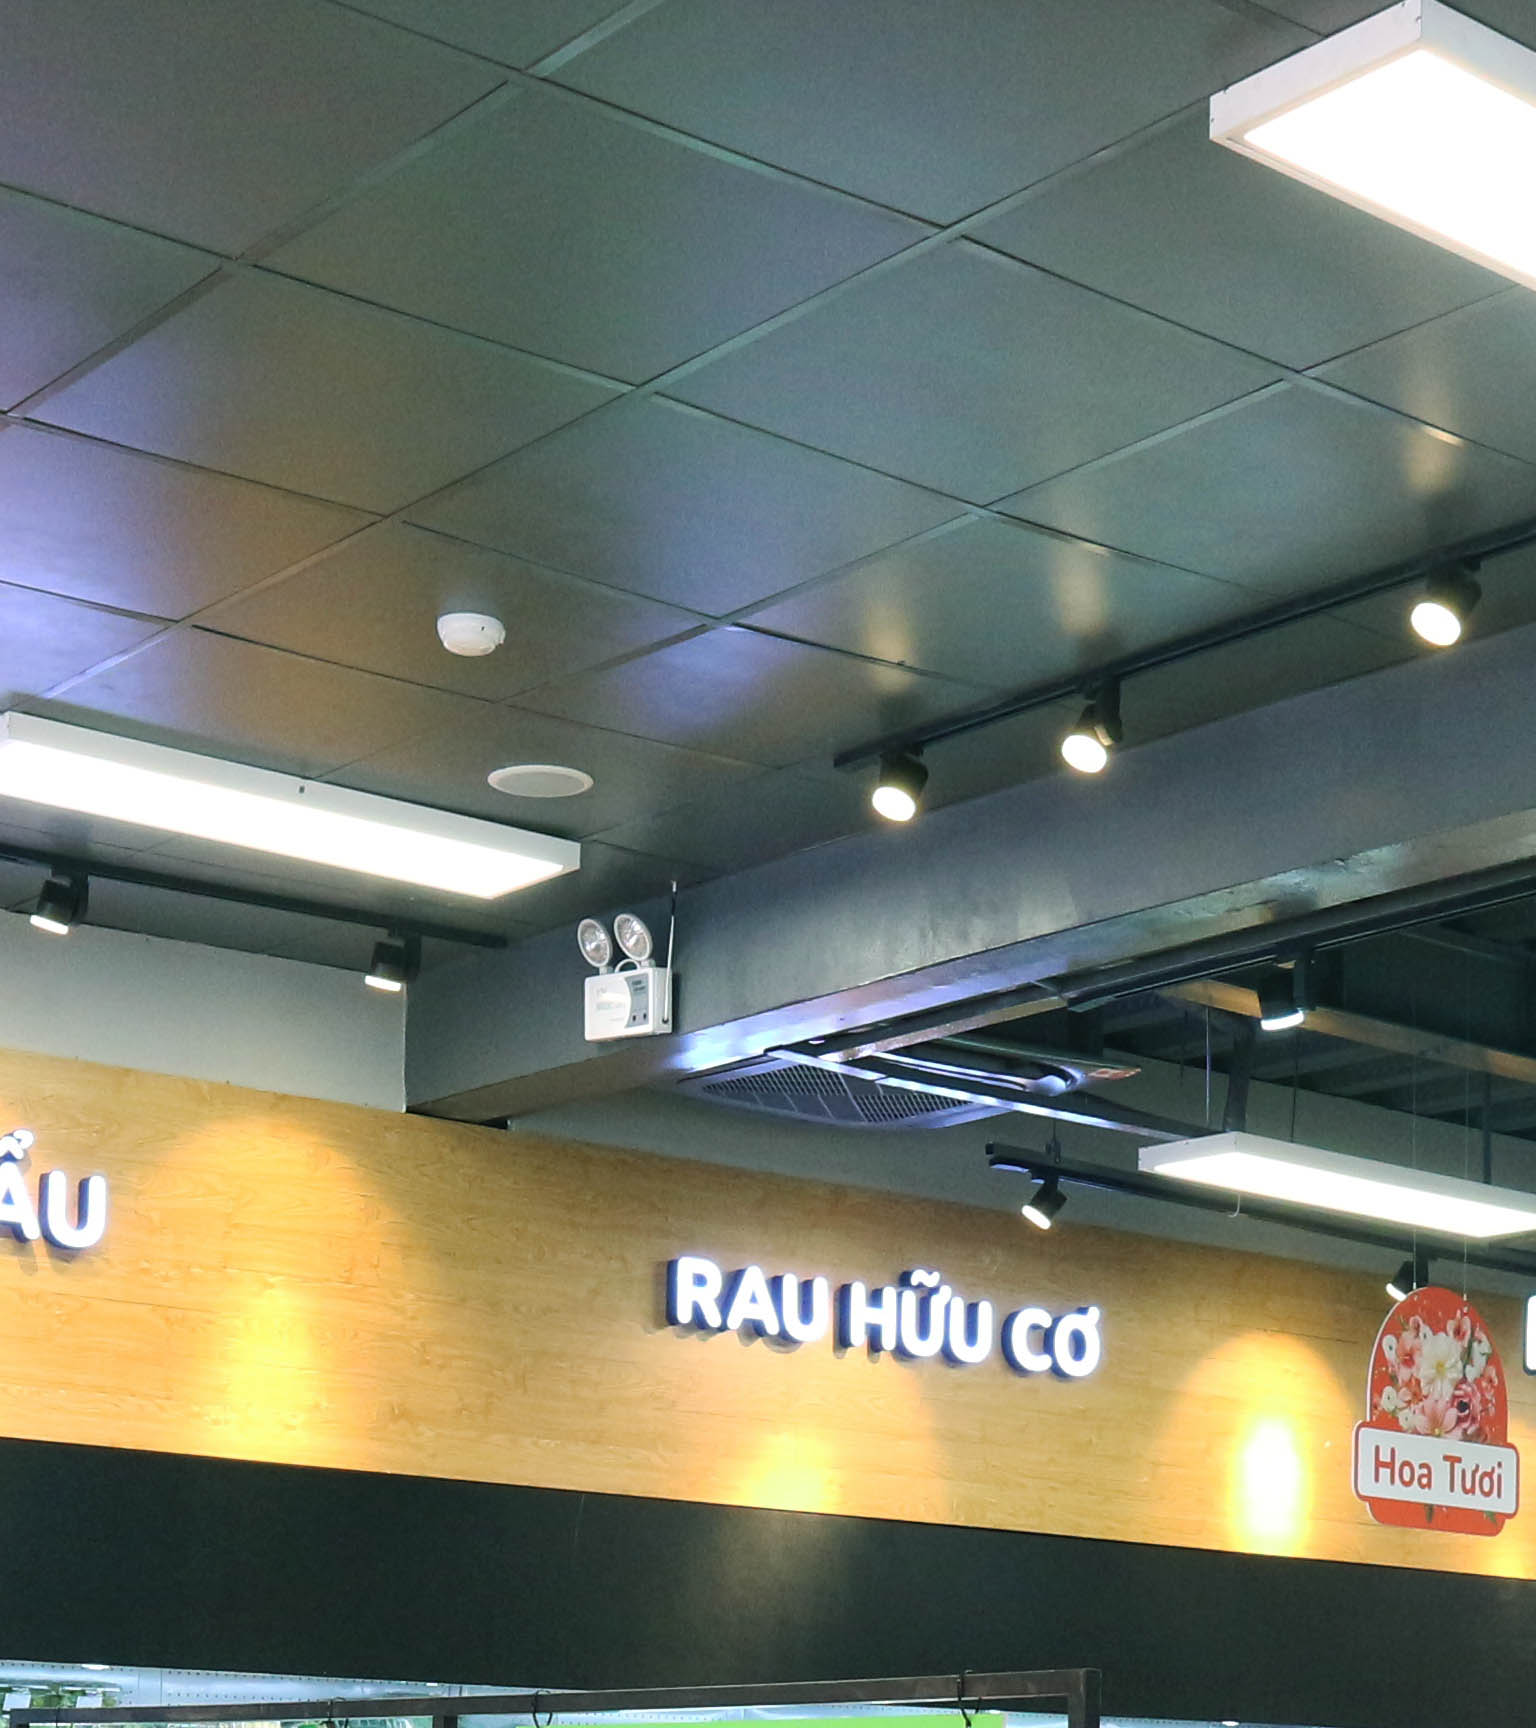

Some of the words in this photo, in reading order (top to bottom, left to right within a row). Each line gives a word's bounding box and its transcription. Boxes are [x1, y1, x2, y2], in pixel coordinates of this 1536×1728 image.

[668, 1256, 830, 1344] RAU
[840, 1269, 994, 1365] HỮU
[1003, 1305, 1101, 1378] CƠ
[1374, 1444, 1432, 1490] Hoa
[1443, 1454, 1503, 1499] Tươi
